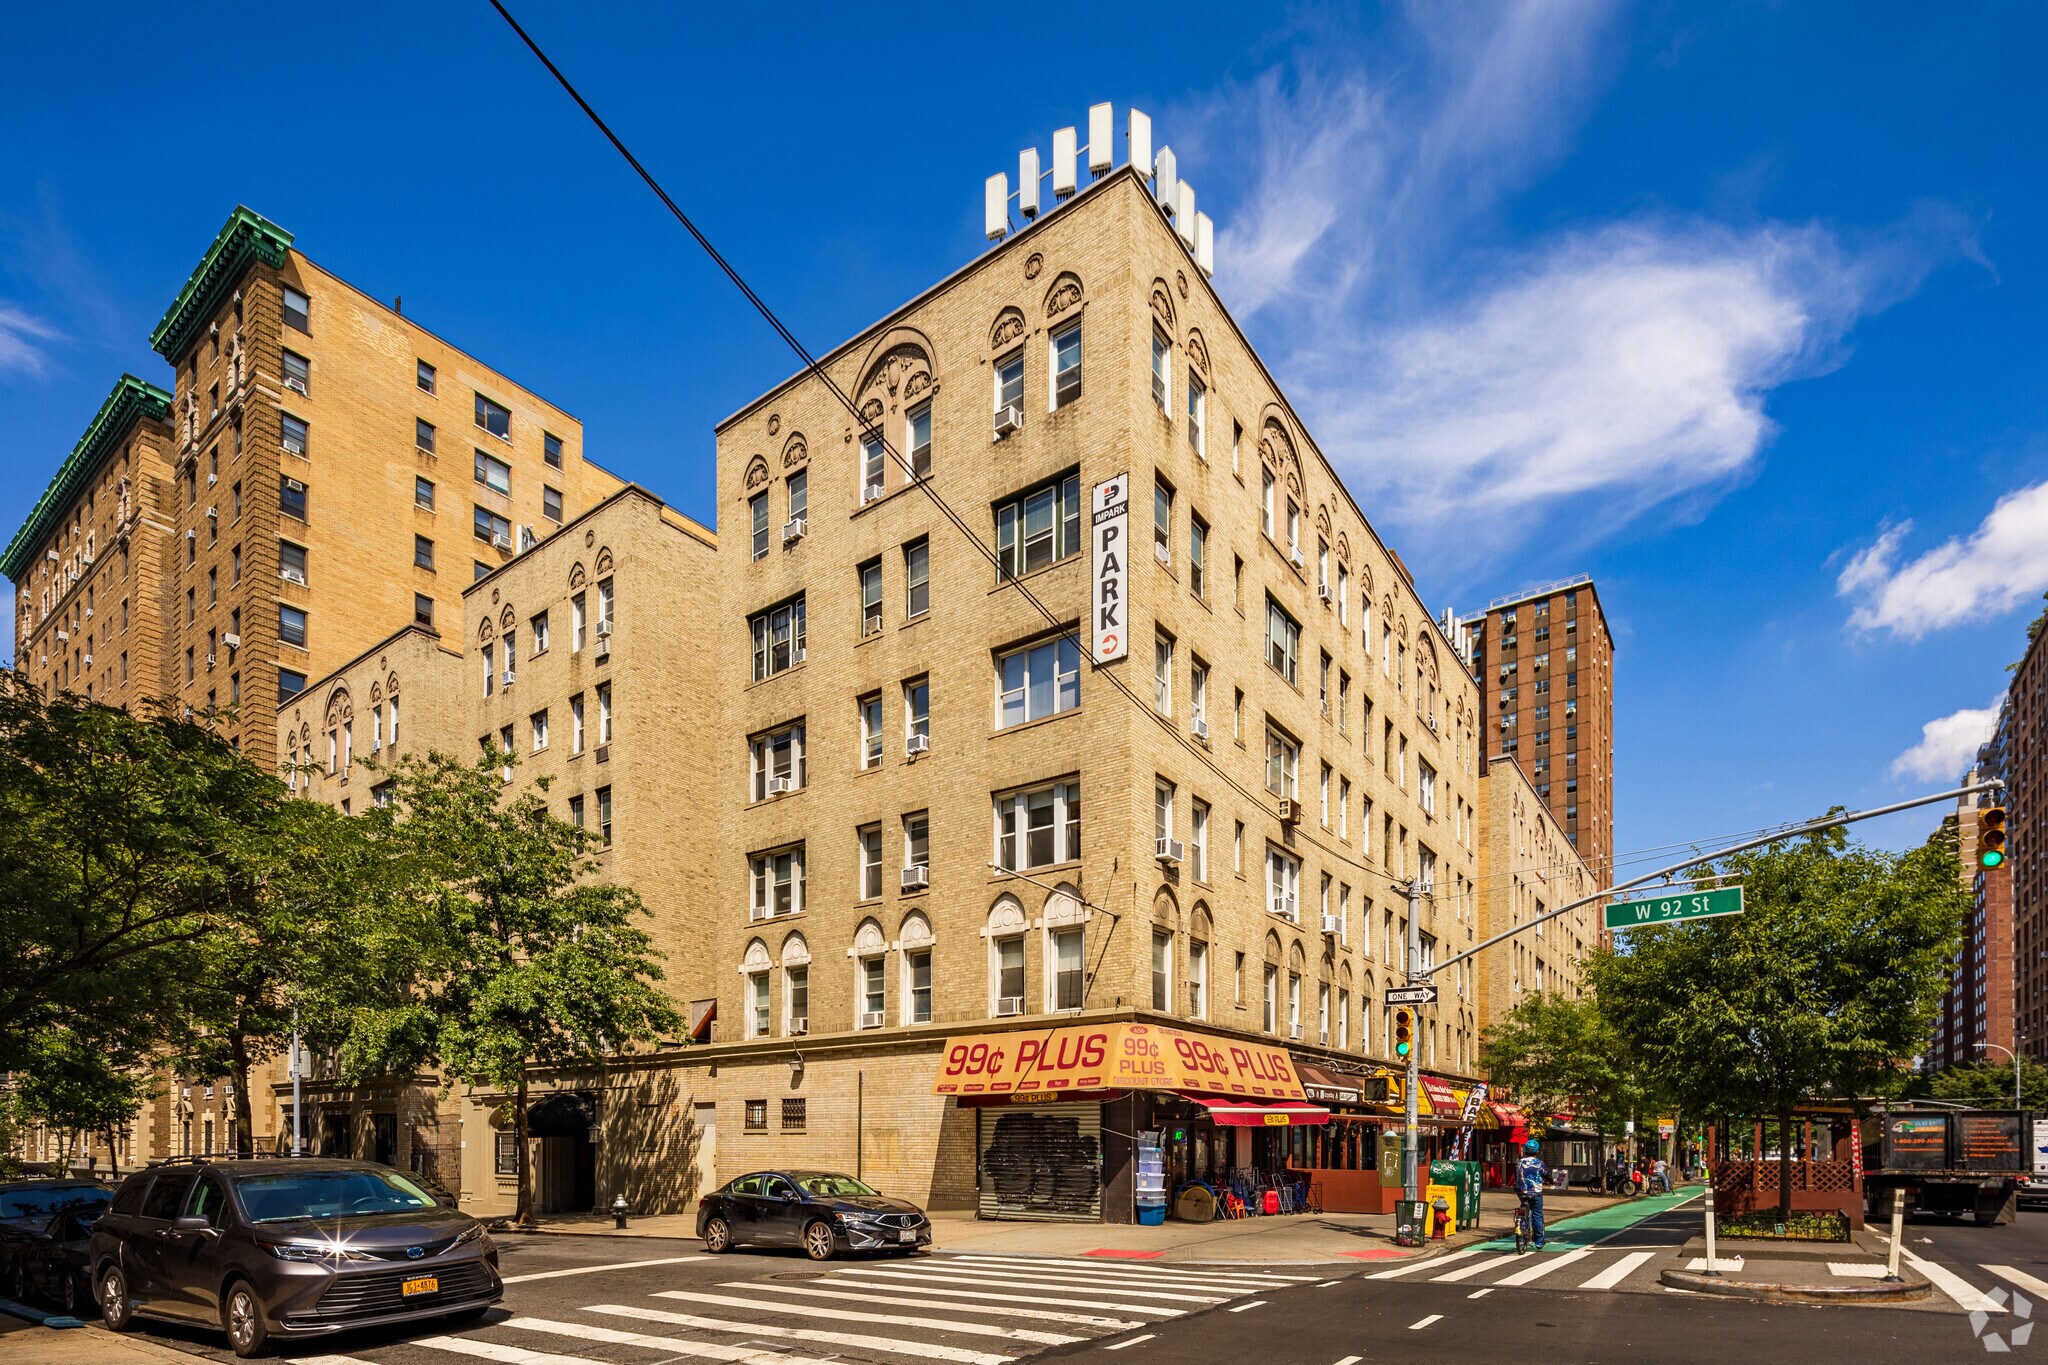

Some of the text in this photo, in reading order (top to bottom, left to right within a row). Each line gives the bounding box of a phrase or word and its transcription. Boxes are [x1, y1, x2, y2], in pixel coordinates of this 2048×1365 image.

[1095, 503, 1126, 524] IMPARK
[1099, 525, 1121, 631] PARK
[1635, 896, 1710, 920] W 92 St
[1392, 991, 1430, 1000] ONE WAY
[946, 1033, 1108, 1078] 99¢ PLUS
[1124, 1038, 1159, 1060] 99¢
[1119, 1059, 1166, 1075] PLUS
[1174, 1038, 1292, 1083] 99¢ PLUS
[1112, 1076, 1149, 1086] DISCOUNT
[1150, 1077, 1174, 1086] STORE
[1031, 1093, 1052, 1101] PLUS
[1275, 1115, 1287, 1123] PLUS
